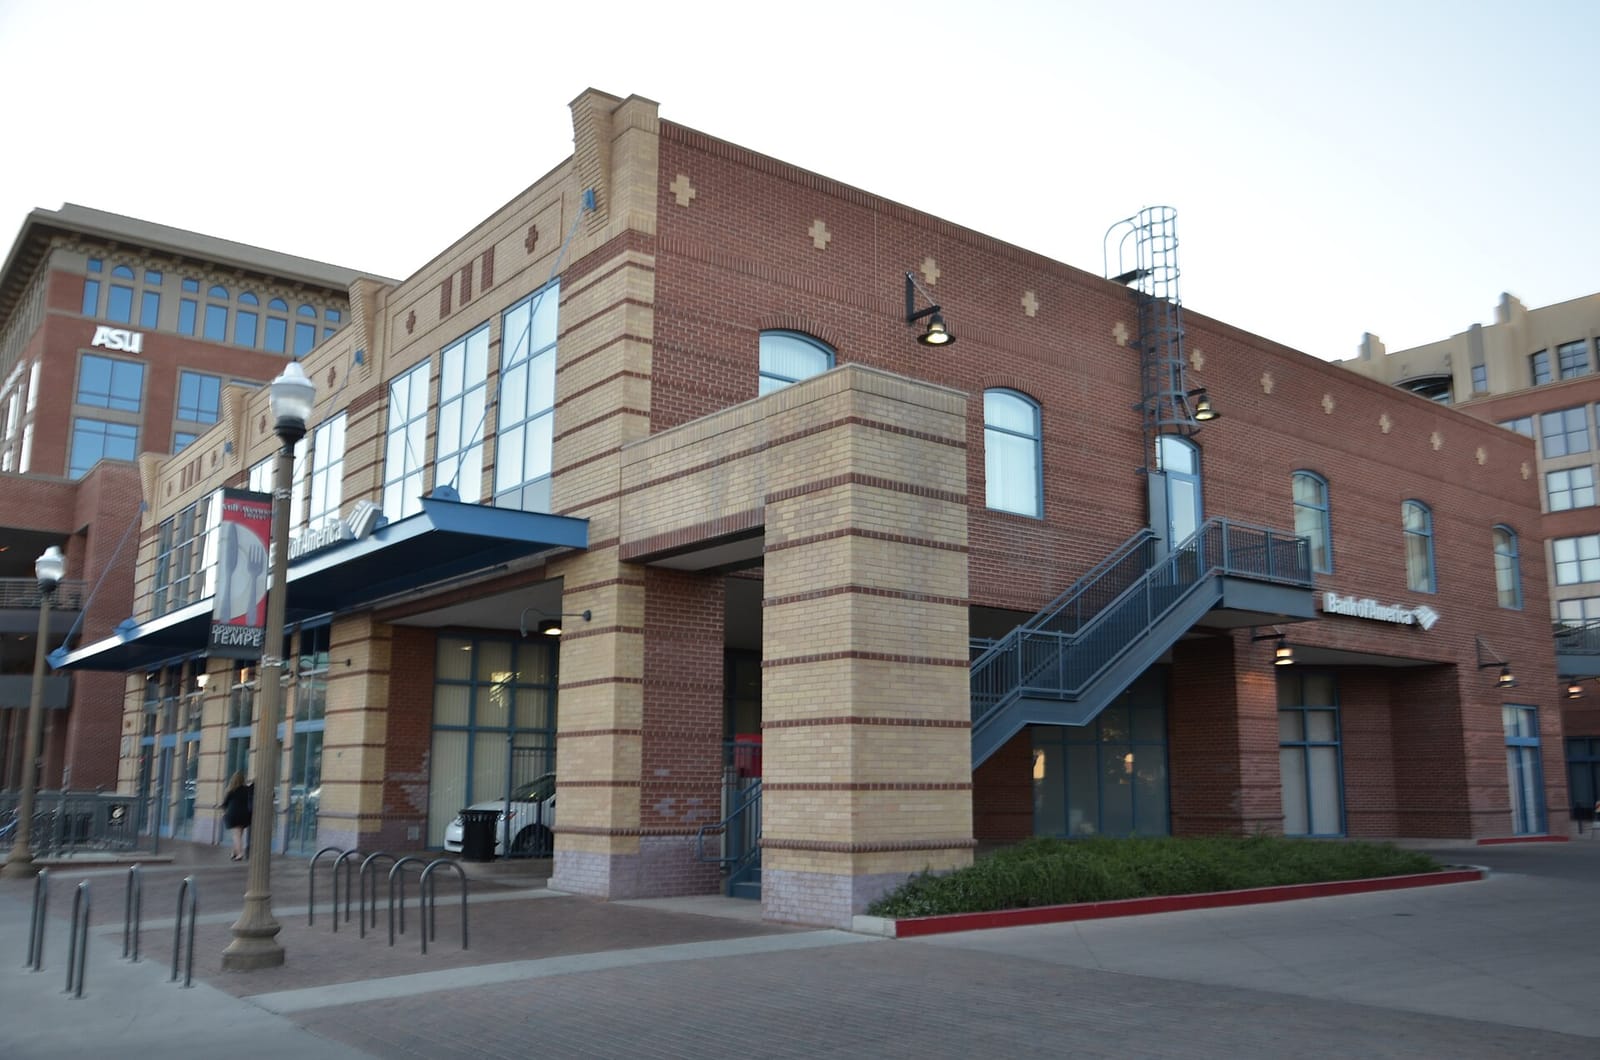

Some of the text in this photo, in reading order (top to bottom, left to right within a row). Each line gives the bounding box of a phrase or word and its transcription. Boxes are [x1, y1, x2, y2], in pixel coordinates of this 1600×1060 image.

[91, 325, 144, 354] ASU
[301, 522, 342, 554] America
[1323, 592, 1357, 613] Bank
[1367, 599, 1413, 625] America
[212, 624, 261, 637] DOWNTOWN
[212, 631, 261, 647] TEMPE
